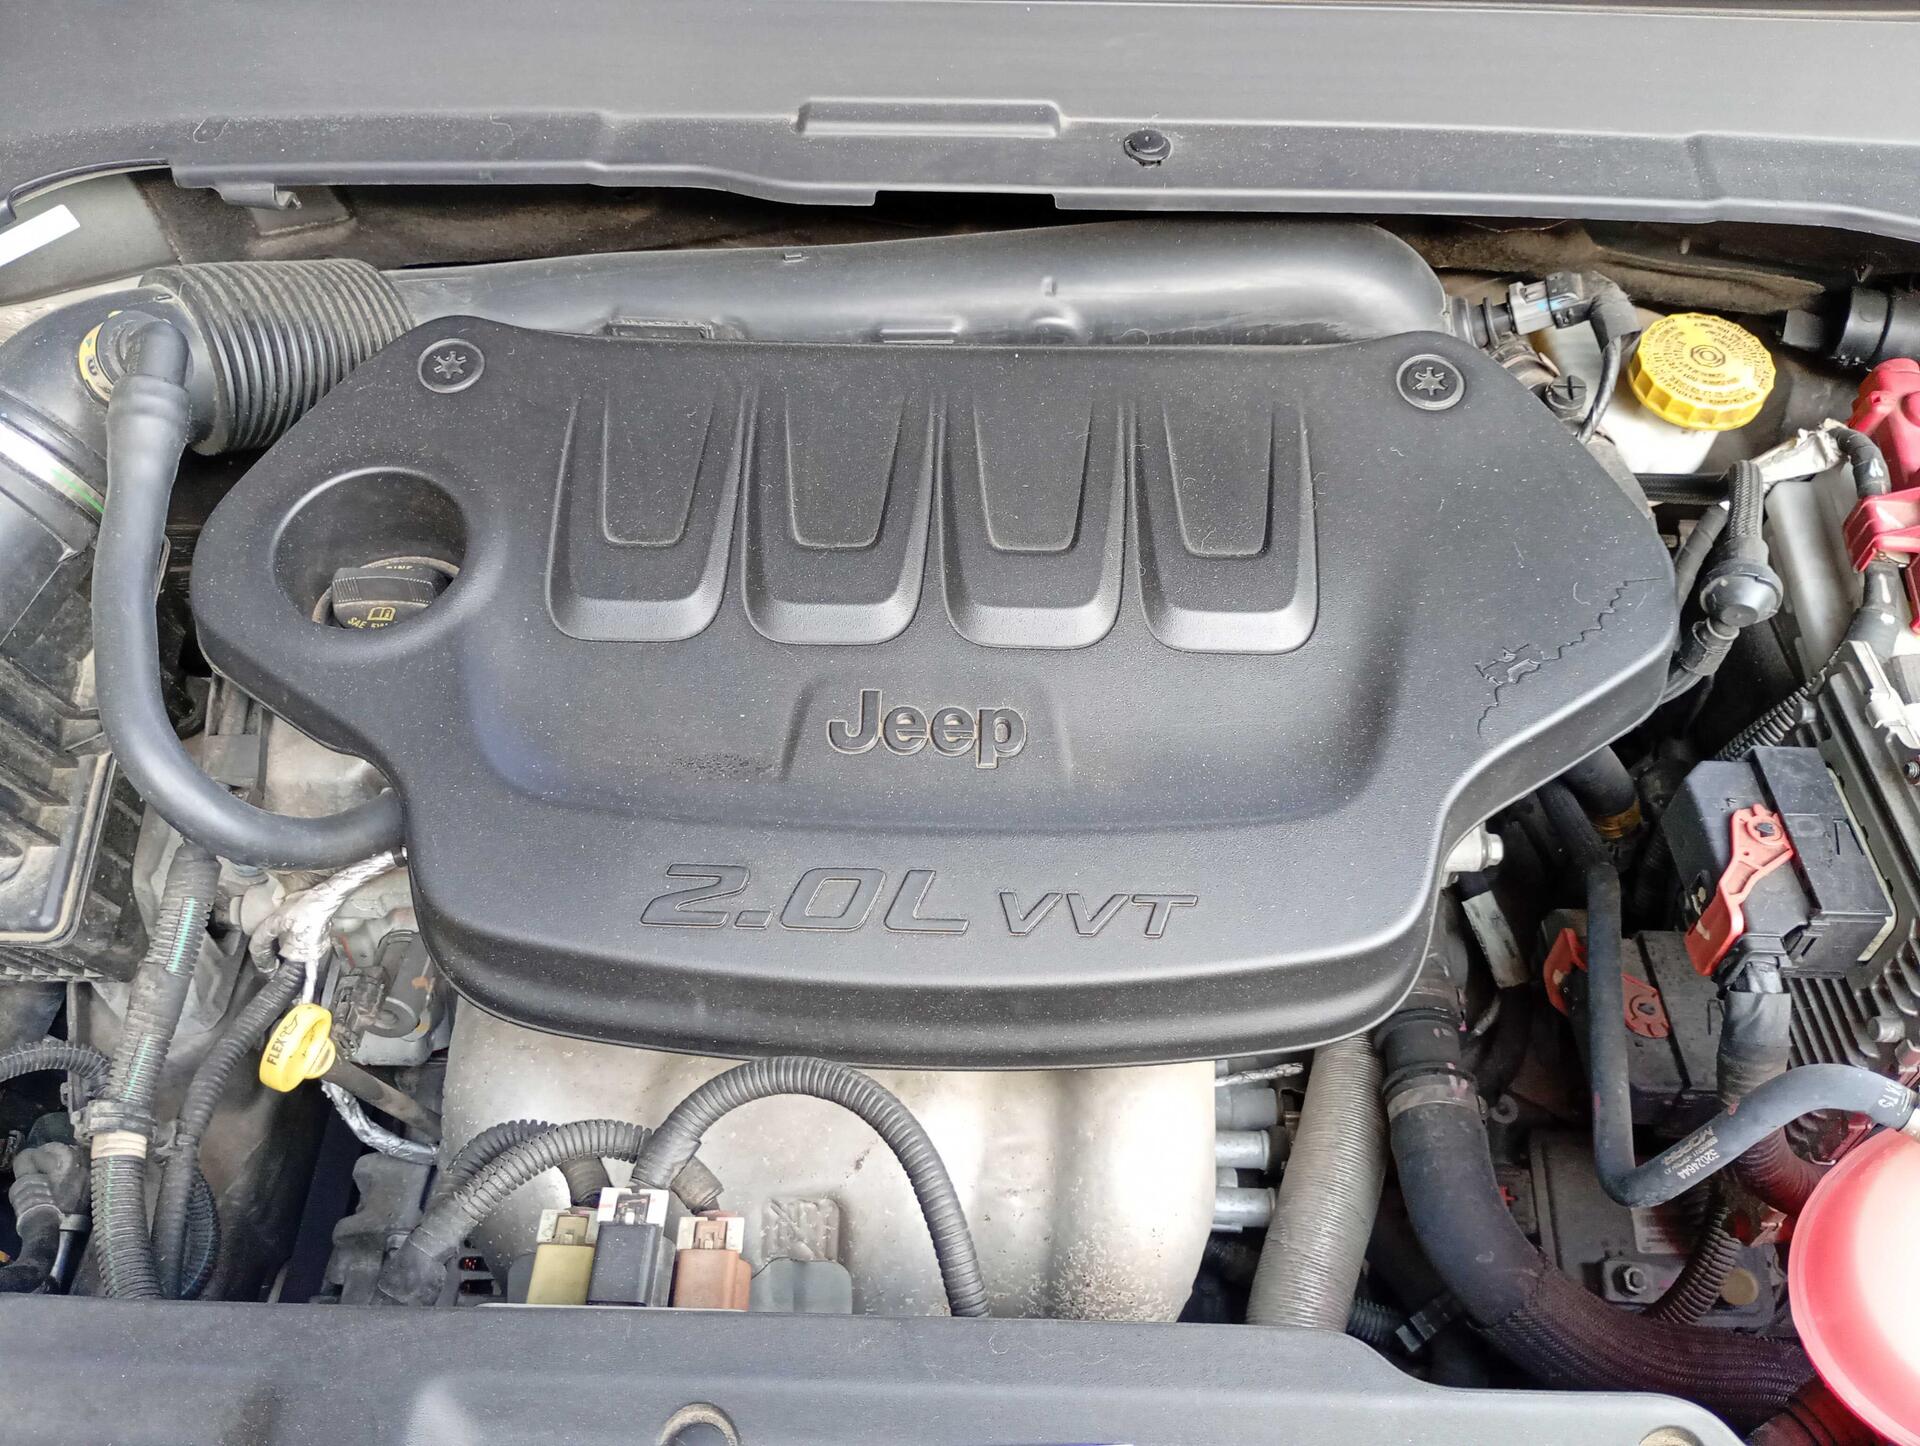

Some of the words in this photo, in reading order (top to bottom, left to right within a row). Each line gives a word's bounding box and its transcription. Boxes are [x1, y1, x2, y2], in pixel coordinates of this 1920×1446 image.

[347, 616, 368, 629] SAE
[826, 688, 1028, 769] Jeep
[640, 862, 970, 936] 2.0L
[999, 891, 1199, 939] VVT
[266, 1037, 287, 1066] FLEX
